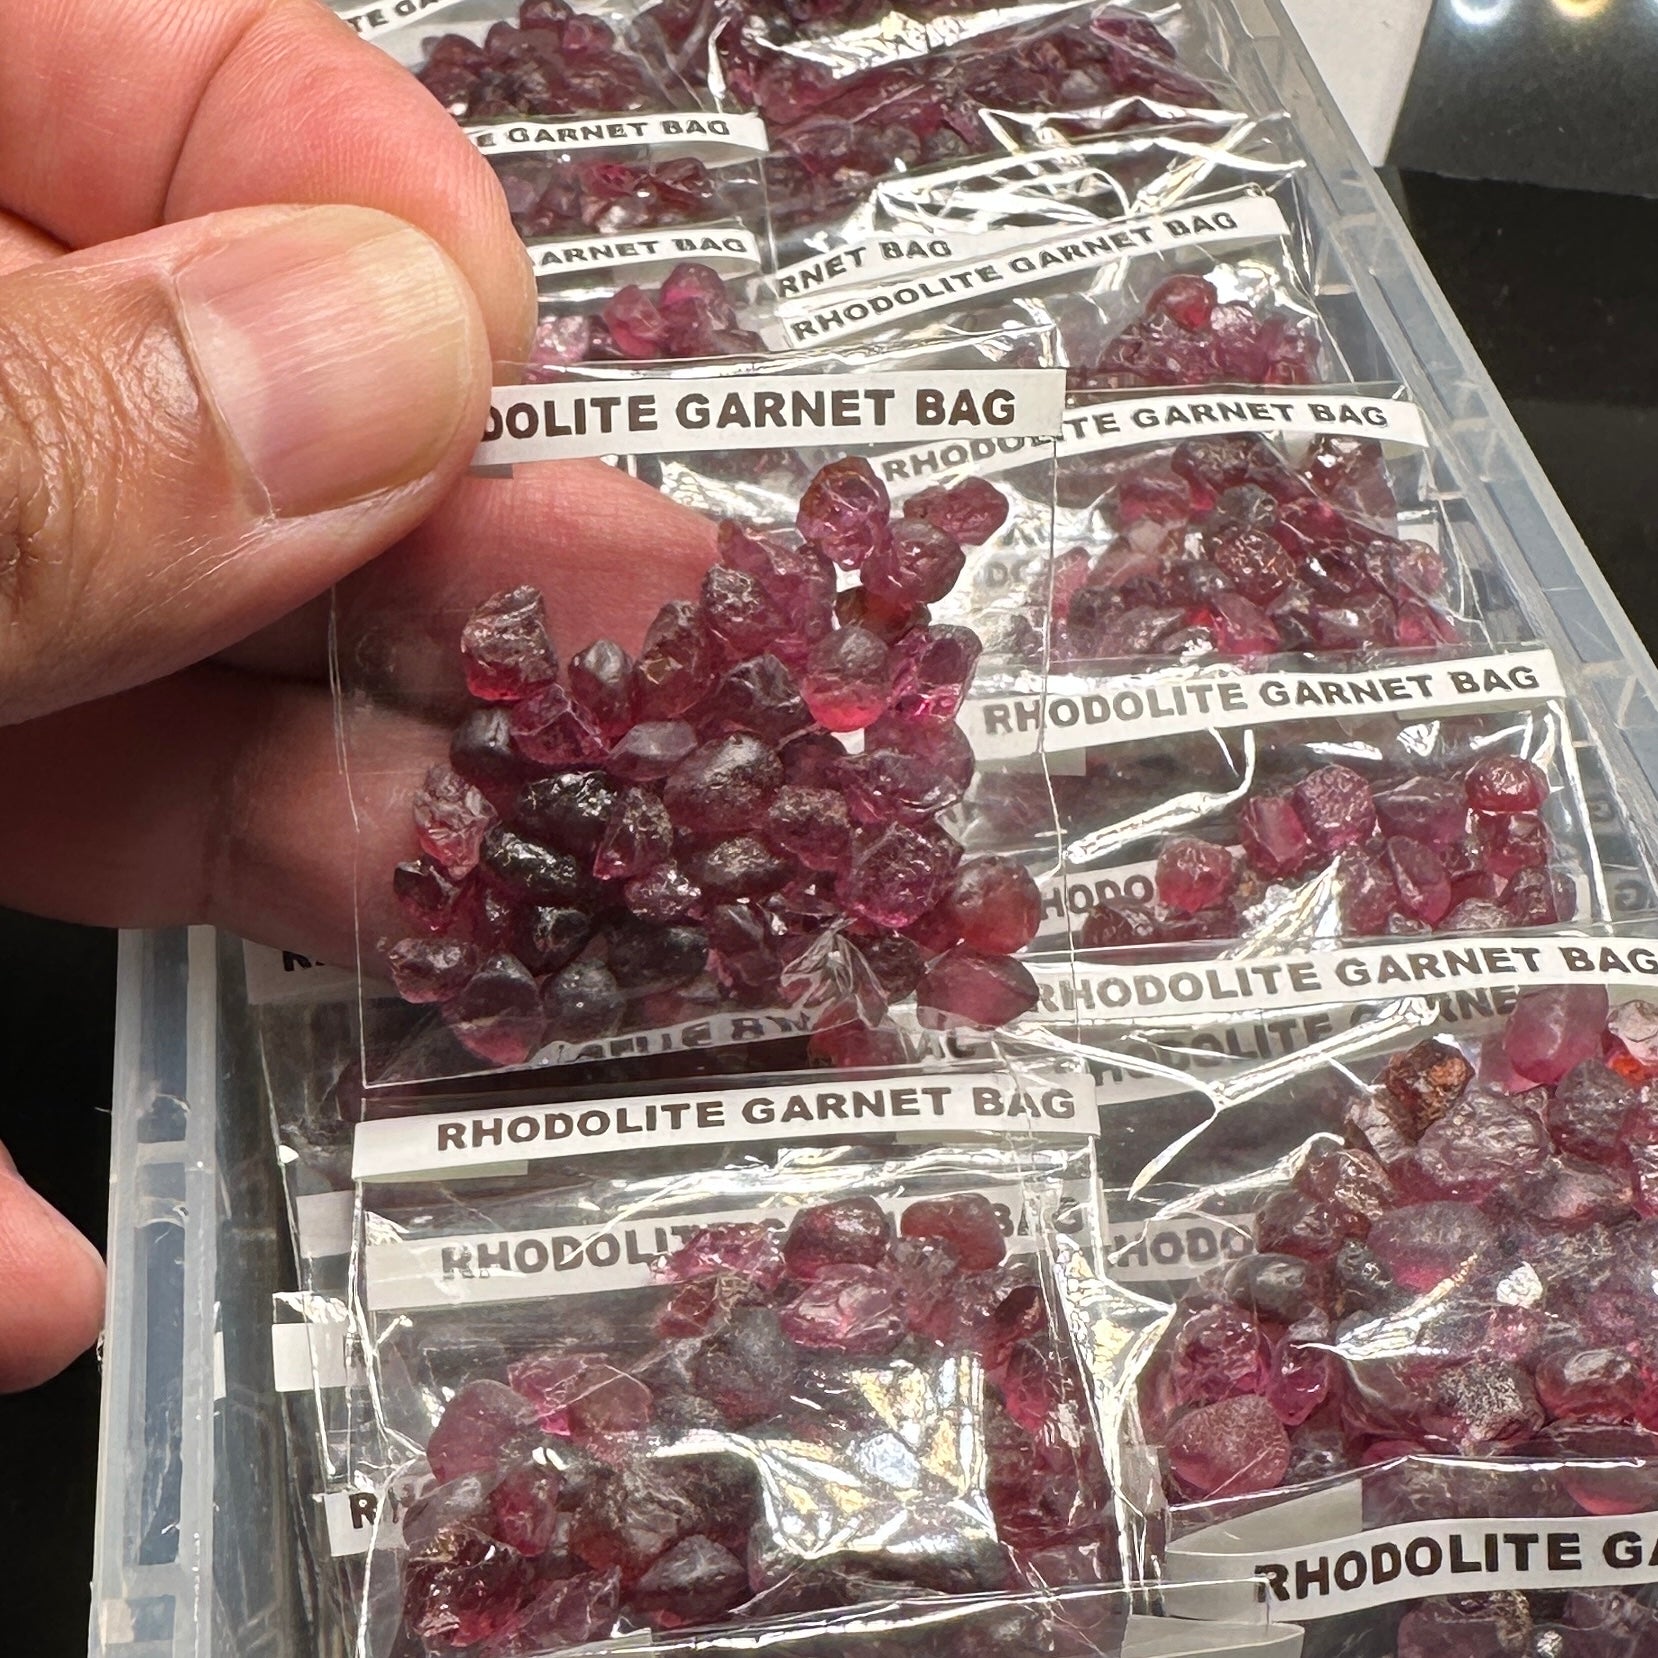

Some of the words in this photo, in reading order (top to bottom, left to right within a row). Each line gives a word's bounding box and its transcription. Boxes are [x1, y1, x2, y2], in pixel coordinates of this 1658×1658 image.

[541, 240, 660, 266] ARNET
[779, 246, 867, 297] RNET
[792, 262, 1003, 341] RHODOLITE
[1009, 227, 1155, 275] GARNET
[675, 388, 895, 430] GARNET
[915, 388, 1016, 426] BAG
[1130, 402, 1295, 429] GARNET
[1312, 402, 1389, 426] BAG
[982, 681, 1248, 733] RHODOLITE
[1258, 674, 1433, 708] GARNET
[1447, 665, 1540, 691] BAG
[1335, 946, 1542, 985] GARNET
[1559, 945, 1658, 975] BAG
[436, 1100, 726, 1151] RHODOLITE
[741, 1086, 952, 1124] GARNET
[971, 1086, 1076, 1120] BAG
[1255, 1532, 1583, 1603] RHODOLITE
